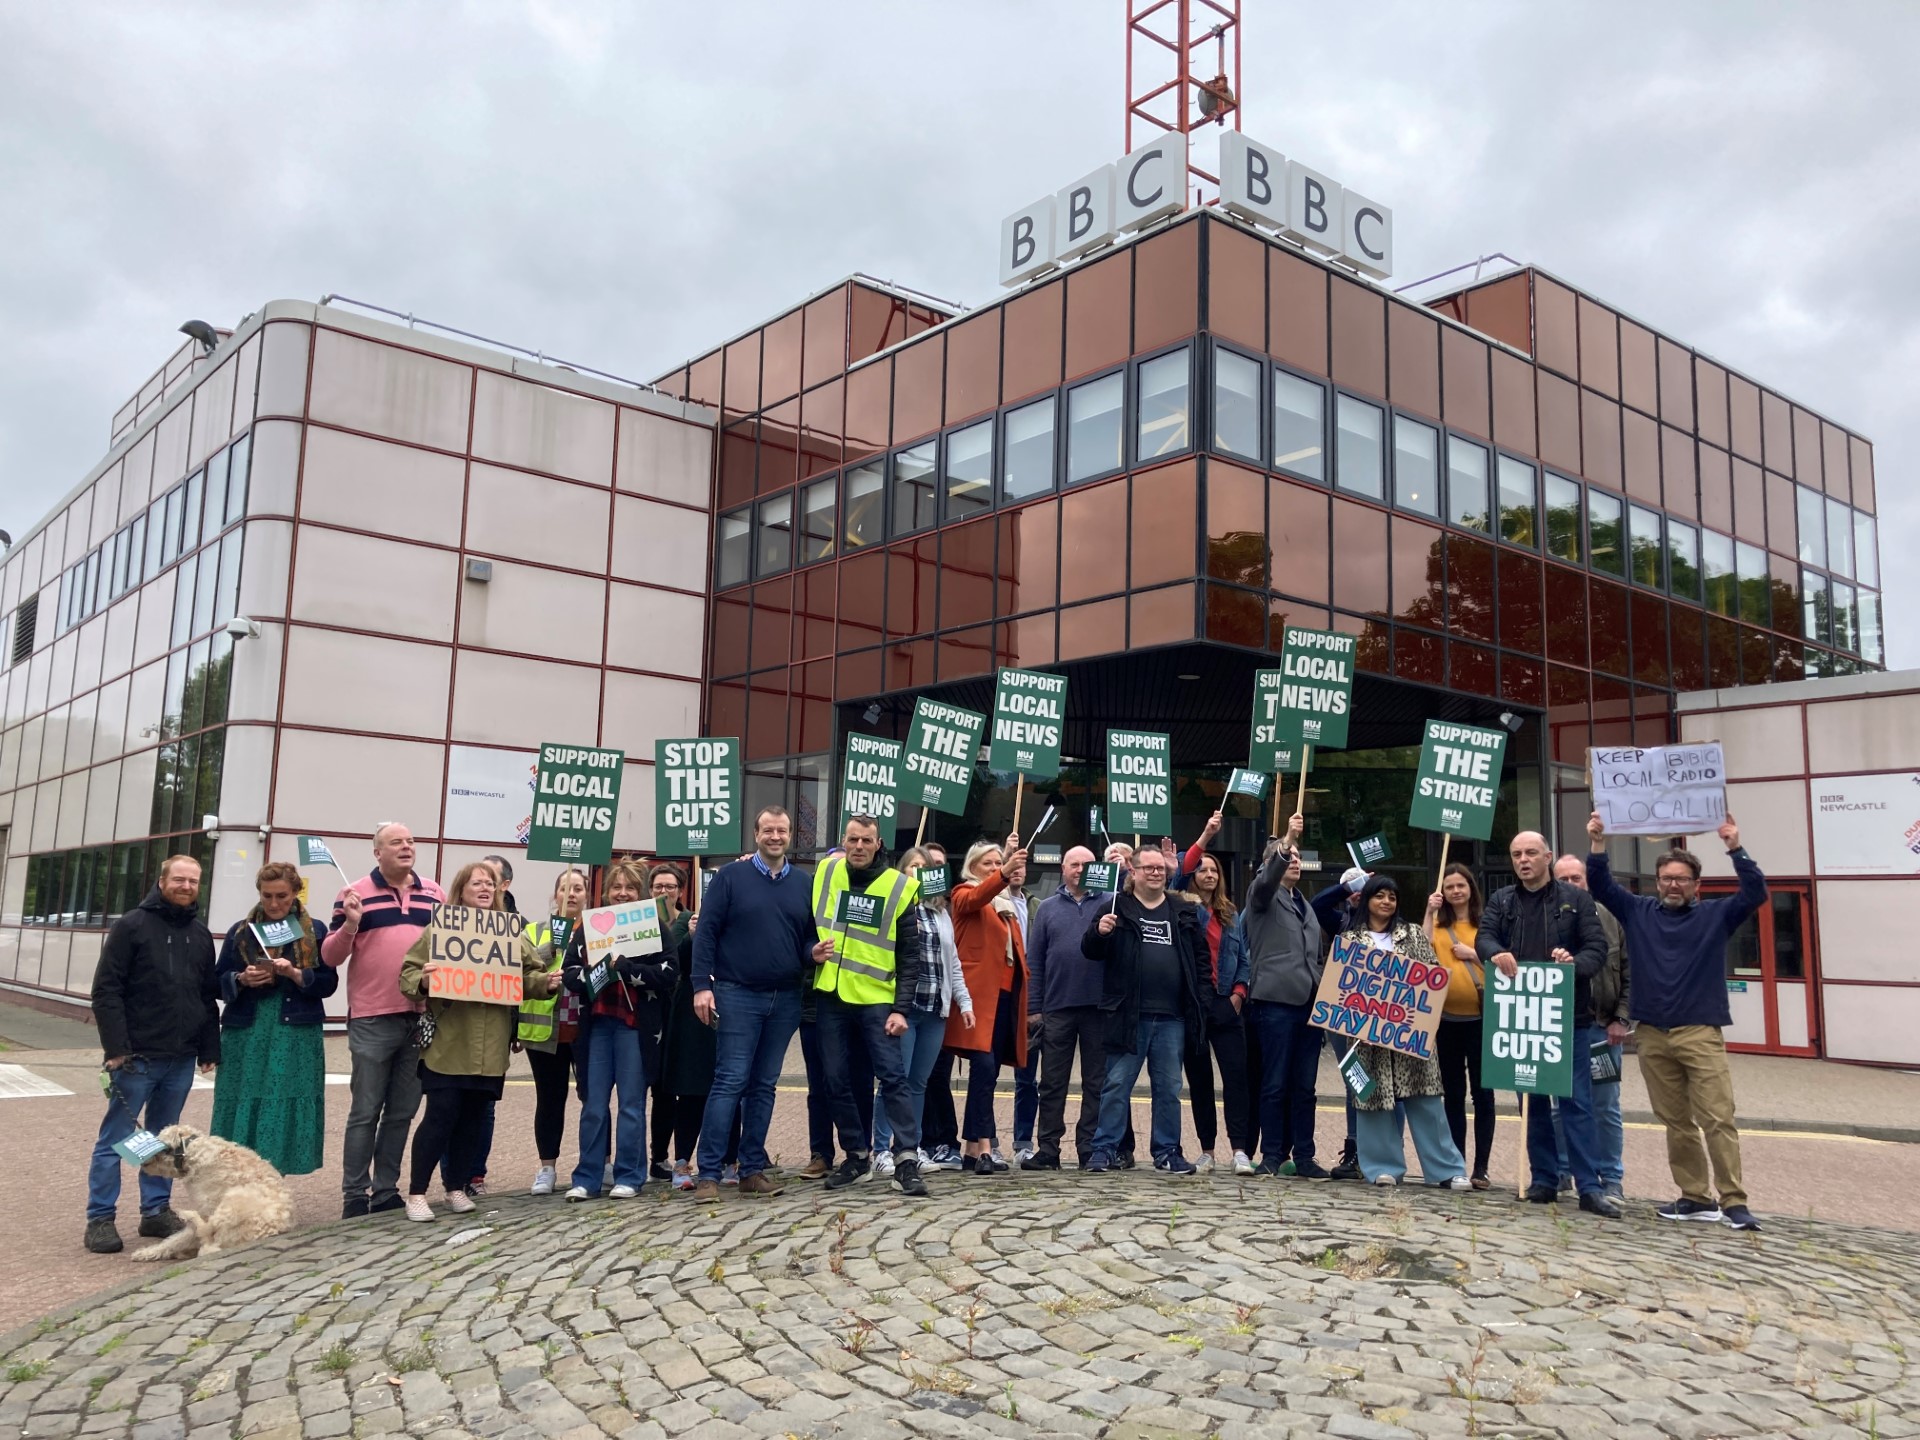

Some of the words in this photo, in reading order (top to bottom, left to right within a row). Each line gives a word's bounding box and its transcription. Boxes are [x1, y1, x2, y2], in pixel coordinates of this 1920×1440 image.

[1011, 149, 1163, 270] BBC
[1247, 146, 1384, 262] BBC
[1287, 630, 1353, 653] SUPPORT
[1284, 654, 1349, 683] LOCAL
[1001, 671, 1064, 692] SUPPORT
[999, 692, 1060, 720] LOCAL
[1281, 684, 1347, 715] NEWS
[918, 702, 982, 731] SUPPORT
[1303, 719, 1322, 729] NUJ
[921, 722, 971, 761] THE
[996, 718, 1058, 748] NEWS
[1110, 733, 1166, 750] SUPPORT
[1428, 724, 1503, 749] SUPPORT
[544, 747, 620, 769] SUPPORT
[664, 742, 730, 766] STOP
[850, 737, 900, 759] SUPPORT
[1016, 750, 1034, 760] NUJ
[1596, 750, 1645, 765] KEEP
[848, 760, 896, 788] LOCAL
[906, 752, 970, 786] STRIKE
[1110, 754, 1168, 778] LOCAL
[1433, 745, 1492, 782] THE
[540, 772, 615, 800] LOCAL
[664, 768, 730, 800] THE
[924, 784, 942, 795] NUJ
[1241, 772, 1264, 784] NUJ
[1601, 770, 1662, 789] LOCAL
[1668, 768, 1716, 783] RADIO
[844, 788, 895, 818] NEWS
[1111, 782, 1168, 806] NEWS
[1419, 777, 1494, 808] STRIKE
[535, 802, 612, 832] NEWS
[665, 802, 730, 827] CUTS
[1132, 811, 1148, 820] NUJ
[1442, 808, 1463, 819] NUJ
[1820, 802, 1887, 812] NEWCASTLE
[308, 839, 326, 849] NU
[562, 838, 582, 847] NUJ
[688, 830, 708, 838] NUJ
[1358, 836, 1381, 851] NUJ
[922, 868, 945, 882] NUJ
[1088, 864, 1110, 876] NUJ
[848, 895, 876, 910] NUJ
[262, 920, 289, 934] NUJ
[432, 902, 470, 932] KEEP
[475, 908, 521, 938] RADIO
[616, 906, 656, 926] BBC
[432, 934, 521, 968] LOCAL
[588, 936, 615, 951] KEEP
[633, 927, 661, 942] LOCAL
[589, 961, 607, 983] NUJ
[1494, 966, 1564, 994] STOP
[432, 967, 476, 996] STOP
[481, 972, 523, 1002] CUTS
[1338, 966, 1432, 1014] DIGITAL
[1343, 992, 1407, 1023] AND
[1494, 994, 1563, 1033] THE
[1312, 1000, 1370, 1036] STAY
[1367, 1016, 1431, 1058] LOCAL
[1492, 1031, 1562, 1064] CUTS
[1515, 1063, 1538, 1074] NUJ
[1345, 1069, 1364, 1095] NUJ
[124, 1130, 154, 1150] NUJ
